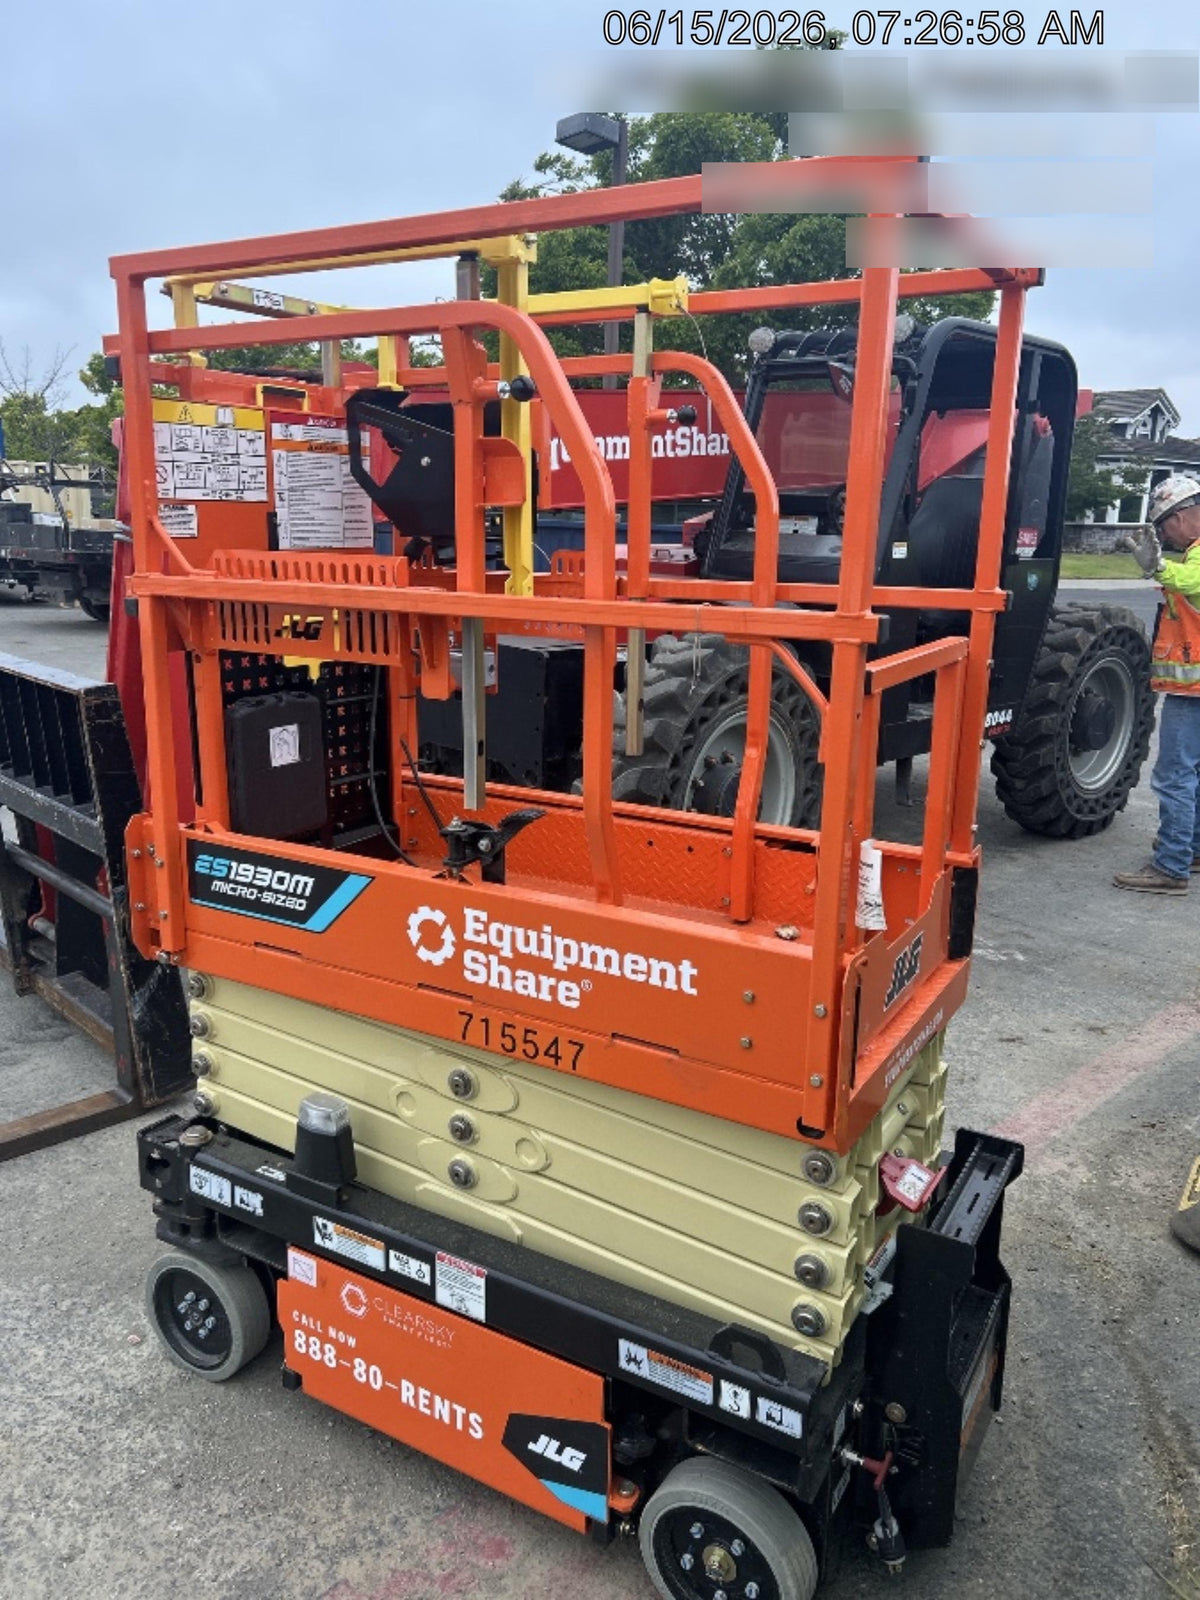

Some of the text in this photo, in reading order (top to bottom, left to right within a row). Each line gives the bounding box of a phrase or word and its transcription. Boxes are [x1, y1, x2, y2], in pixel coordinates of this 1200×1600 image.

[195, 854, 315, 897] ES1930M
[211, 880, 307, 911] MICRO-SIZED
[463, 906, 698, 996] Equipment
[883, 930, 924, 1012] JLG
[458, 1011, 584, 1070] 715547
[292, 1310, 357, 1348] CALL NOW
[373, 1297, 456, 1342] CLEARSKY
[294, 1329, 484, 1440] 888-80-RENTS
[527, 1434, 588, 1474] JLG
